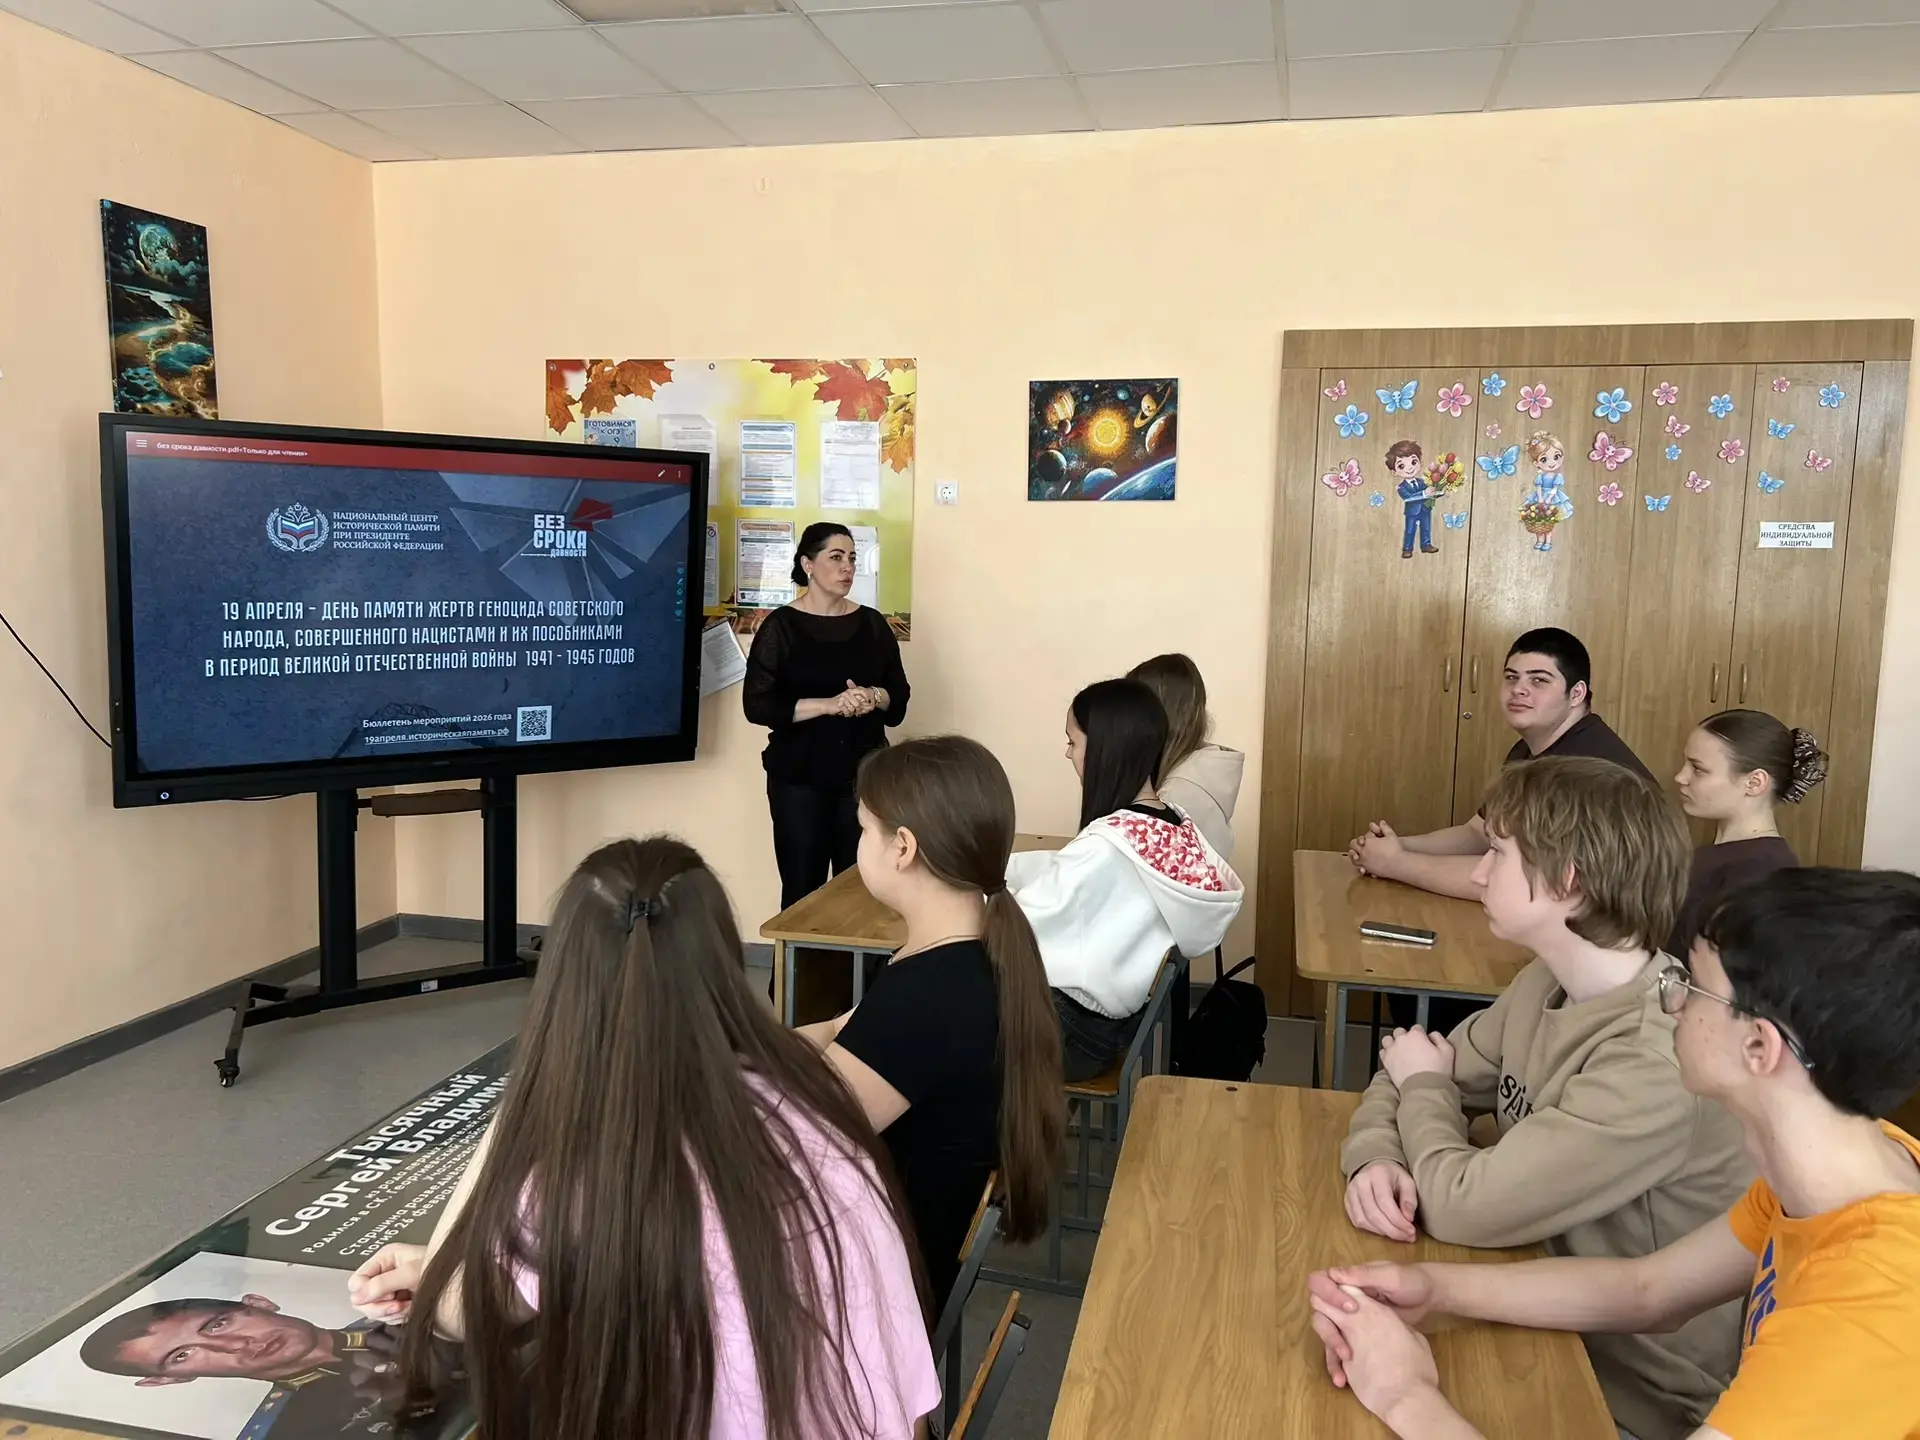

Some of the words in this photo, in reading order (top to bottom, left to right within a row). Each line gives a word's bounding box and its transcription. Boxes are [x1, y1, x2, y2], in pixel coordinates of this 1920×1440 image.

[588, 420, 632, 428] ГОТОВИМСЯ
[171, 444, 193, 452] срока
[333, 511, 408, 521] НАЦИОНАЛЬНЫЙ
[410, 514, 439, 523] ЦЕНТР
[333, 520, 402, 530] ИСТОРИЧЕСКОЙ
[404, 524, 441, 532] ПАМЯТИ
[534, 514, 565, 529] БЕЗ
[354, 532, 410, 541] ПРЕЗИДЕНТЕ
[533, 530, 587, 549] СРОКА
[1760, 531, 1832, 539] ИНДИВИДУАЛЬНОЙ
[333, 541, 391, 550] РОССИЙСКОЙ
[392, 542, 444, 551] ФЕДЕРАЦИИ
[222, 602, 240, 620] 19
[245, 602, 304, 620] АПРЕЛЯ
[321, 601, 359, 621] ДЕНЬ
[364, 601, 424, 619] ПАМЯТИ
[428, 601, 475, 618] ЖЕРТВ
[479, 600, 545, 619] ГЕНОЦИДА
[549, 600, 624, 617] СОВЕТСКОГО
[223, 630, 290, 649] НАРОДА,
[295, 627, 408, 647] СОВЕРШЕННОГО
[412, 625, 496, 645] НАЦИСТАМИ
[500, 626, 507, 642] И
[512, 626, 528, 642] ИХ
[532, 625, 623, 642] ПОСОБНИКАМИ
[205, 659, 215, 677] В
[220, 657, 280, 677] ПЕРИОД
[285, 653, 350, 674] ВЕЛИКОЙ
[355, 649, 467, 672] ОТЕЧЕСТВЕННОЙ
[472, 649, 517, 668] ВОЙНЫ
[525, 650, 552, 666] 1941
[566, 649, 595, 664] 1945
[598, 648, 635, 665] ГОДОВ
[363, 719, 413, 728] Бюллетень
[413, 715, 472, 727] мероприятий
[472, 713, 493, 722] 2026
[493, 713, 512, 721] года
[325, 1073, 488, 1161] Тысячный
[364, 1190, 381, 1198] из
[378, 1171, 408, 1189] рода
[405, 1146, 441, 1171] первых
[385, 1142, 463, 1194] Георгиевский
[265, 1156, 402, 1236] Сергей
[339, 1208, 408, 1256] Старшина
[360, 1228, 400, 1256] погиб
[398, 1217, 415, 1229] 26
